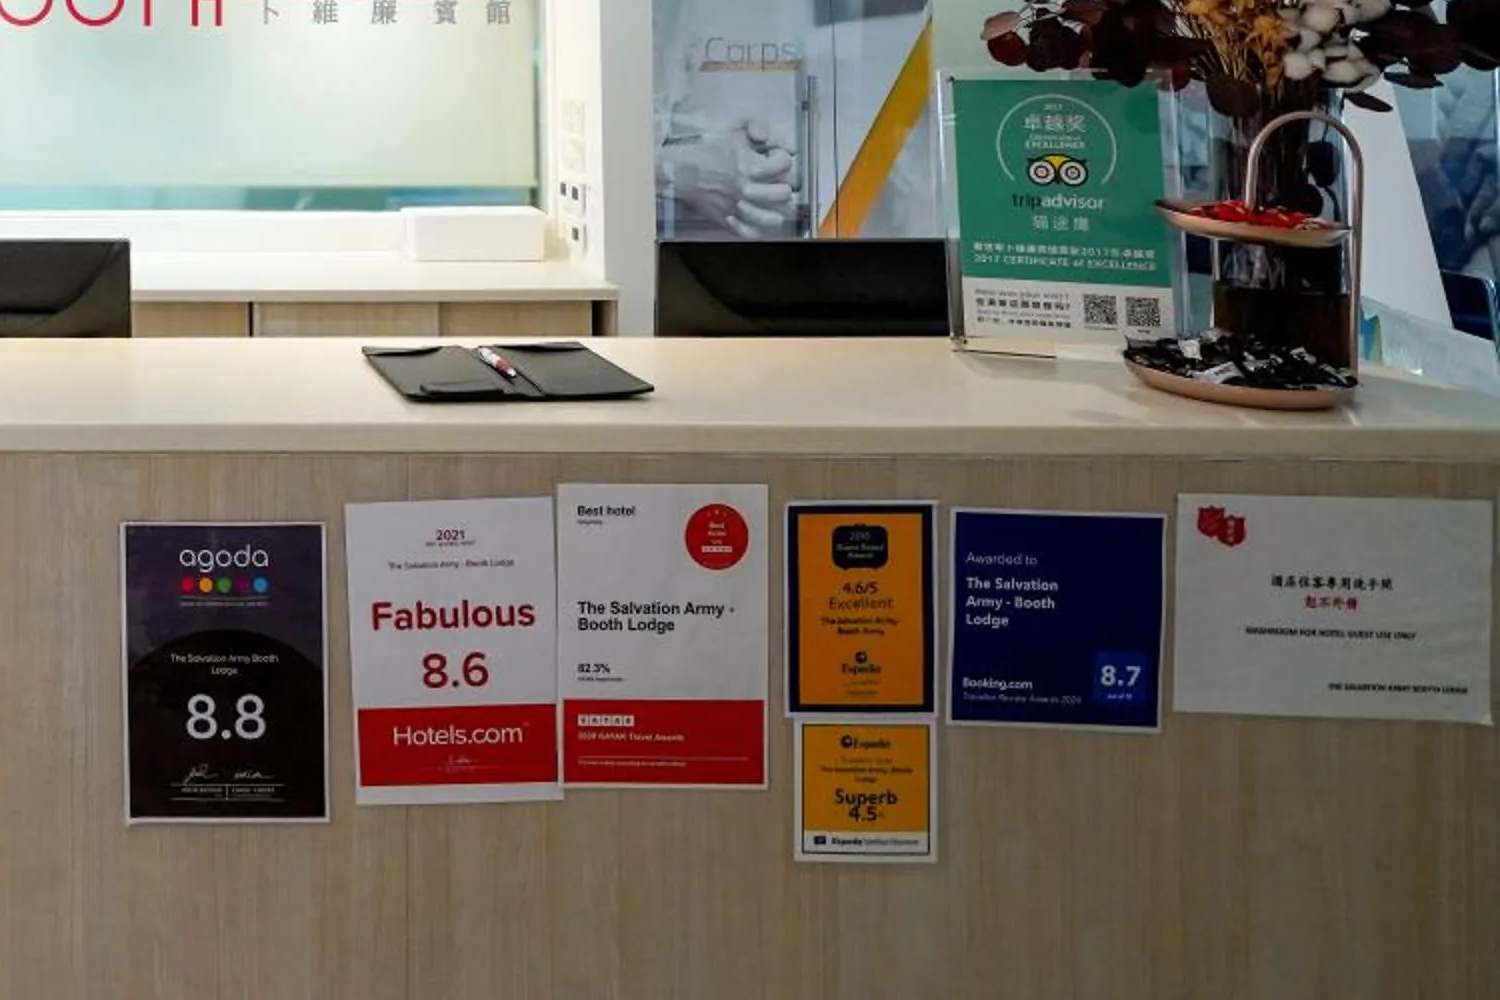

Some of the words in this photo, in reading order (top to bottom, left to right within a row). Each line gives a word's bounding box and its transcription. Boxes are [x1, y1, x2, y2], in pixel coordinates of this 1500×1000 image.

[705, 36, 798, 73] Corps
[577, 506, 604, 516] Best
[607, 506, 636, 516] hotel
[436, 530, 465, 541] 2021
[179, 544, 269, 573] agoda
[965, 552, 1022, 566] Awarded
[1025, 554, 1038, 566] to
[966, 577, 991, 590] The
[995, 577, 1059, 592] Salvation
[578, 602, 605, 615] The
[609, 602, 680, 615] Salvation
[683, 602, 725, 618] Army
[829, 598, 894, 611] Excellent
[965, 596, 1003, 611] Army
[1014, 596, 1055, 609] Booth
[371, 599, 536, 632] Fabulous
[965, 613, 1010, 628] Lodge
[578, 618, 623, 631] Booth
[627, 618, 675, 634] Lodge
[422, 651, 489, 689] 8.6
[1099, 664, 1142, 687] 8.7
[962, 677, 1033, 690] Booking.com
[186, 693, 266, 740] 8.8
[393, 723, 523, 747] Hotels.com
[835, 788, 898, 808] Superb
[848, 806, 877, 822] 4.5
